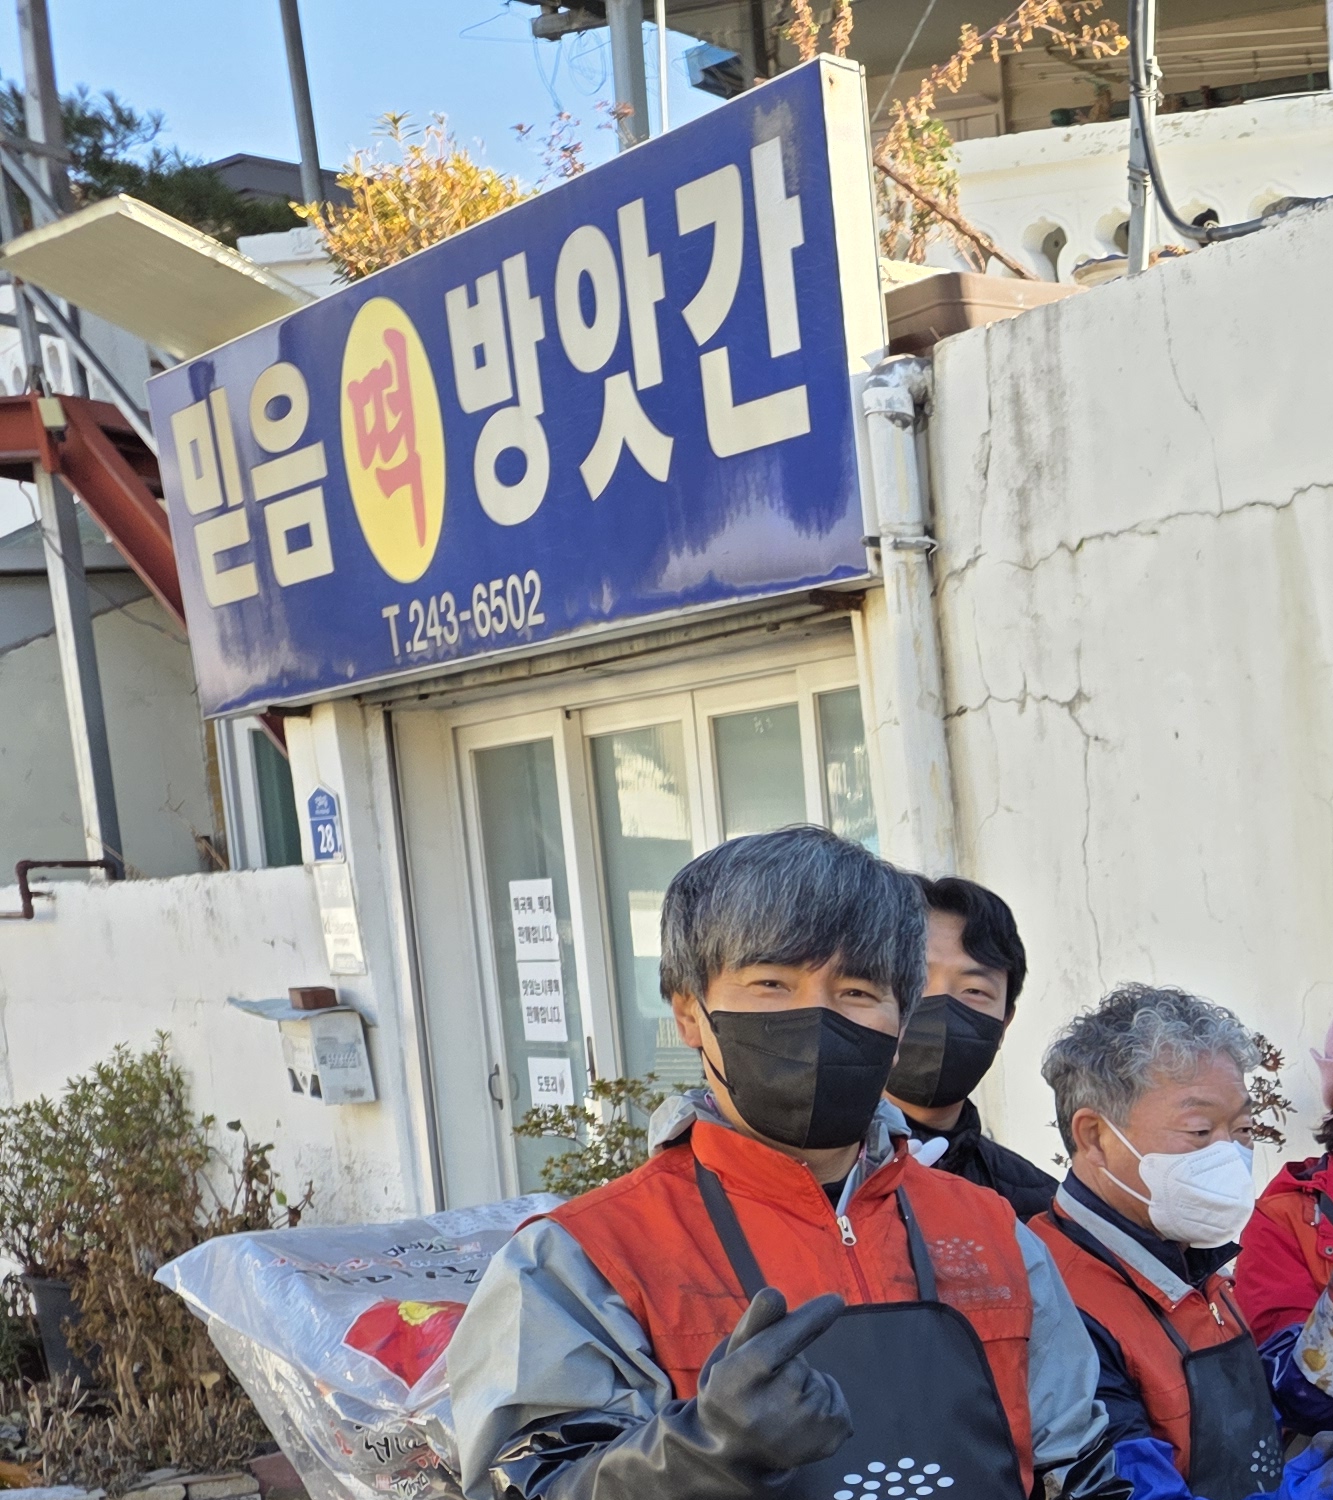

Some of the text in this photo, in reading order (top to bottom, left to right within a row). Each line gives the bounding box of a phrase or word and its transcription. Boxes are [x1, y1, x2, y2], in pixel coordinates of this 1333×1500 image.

[171, 136, 812, 609] 믿음 떡 방앗간
[382, 570, 545, 657] T.243-6502
[318, 824, 334, 853] 28
[537, 1075, 558, 1093] 도토리
